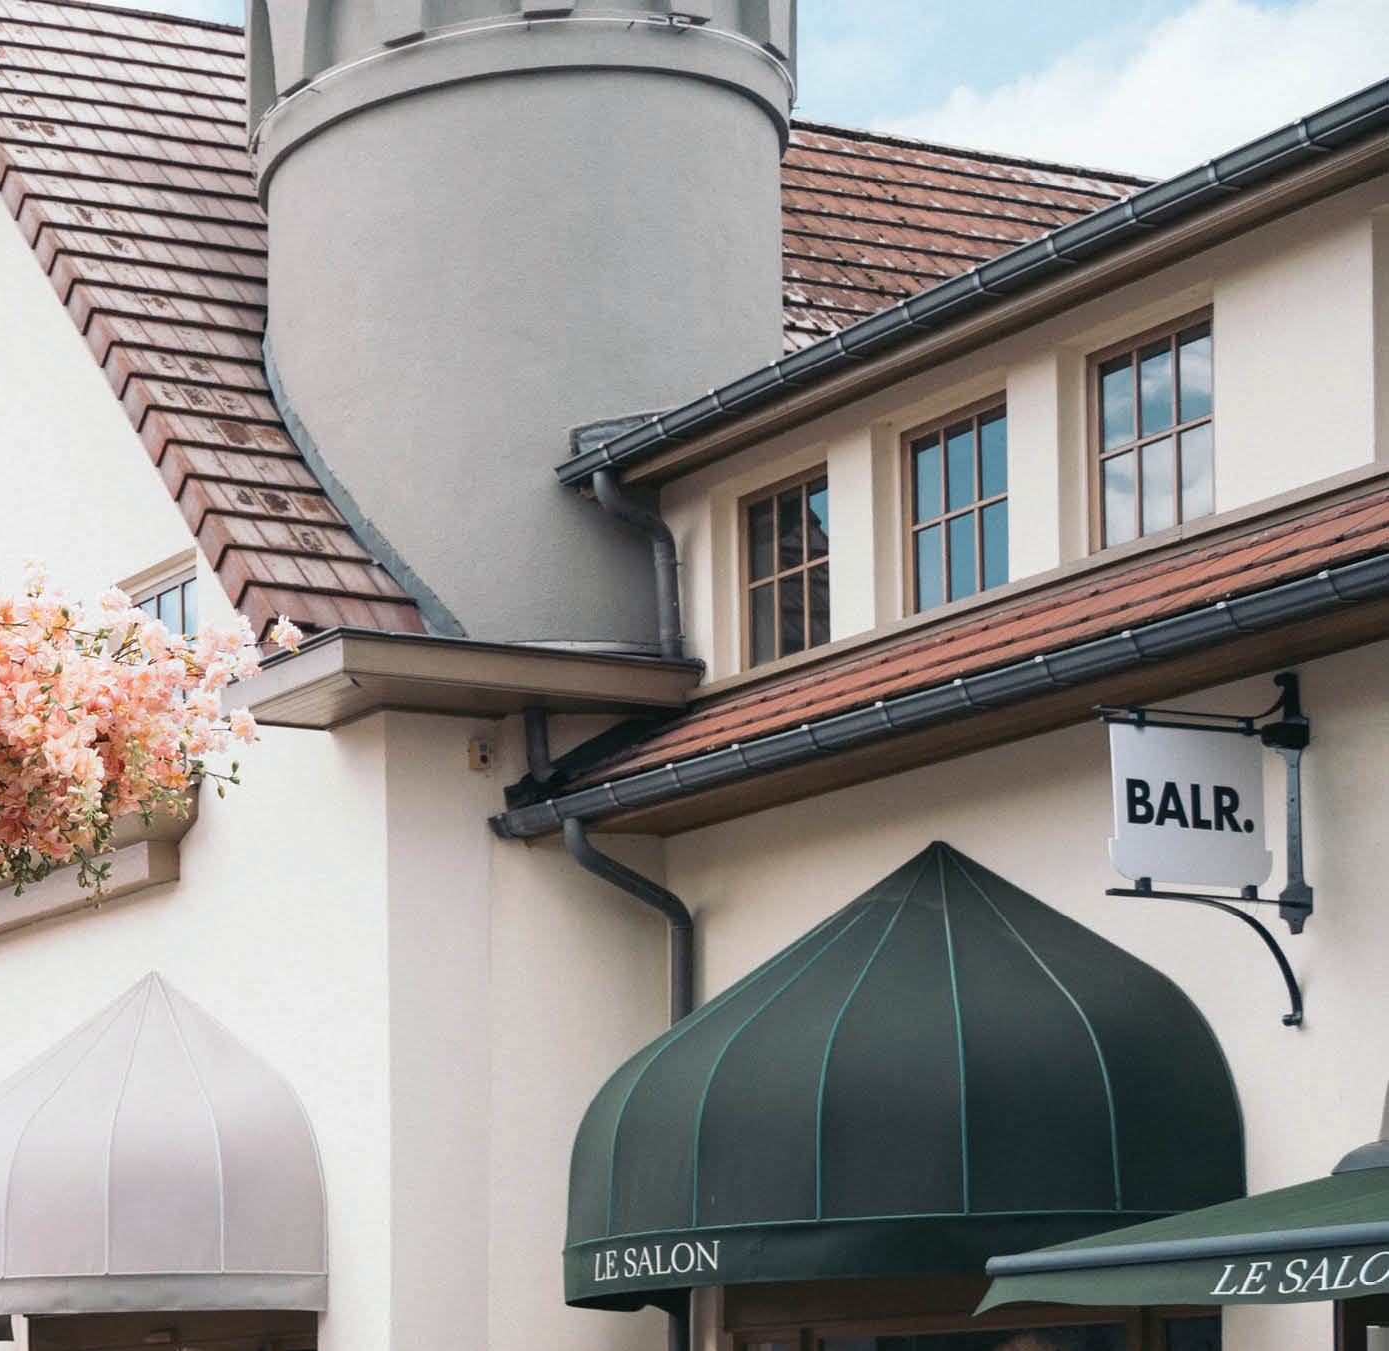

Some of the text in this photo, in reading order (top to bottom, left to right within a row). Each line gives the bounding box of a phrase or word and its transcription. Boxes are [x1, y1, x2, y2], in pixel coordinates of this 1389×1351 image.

[1126, 778, 1255, 833] BALR.
[594, 1239, 721, 1281] LE SALON
[1209, 1250, 1389, 1295] LE SALO
